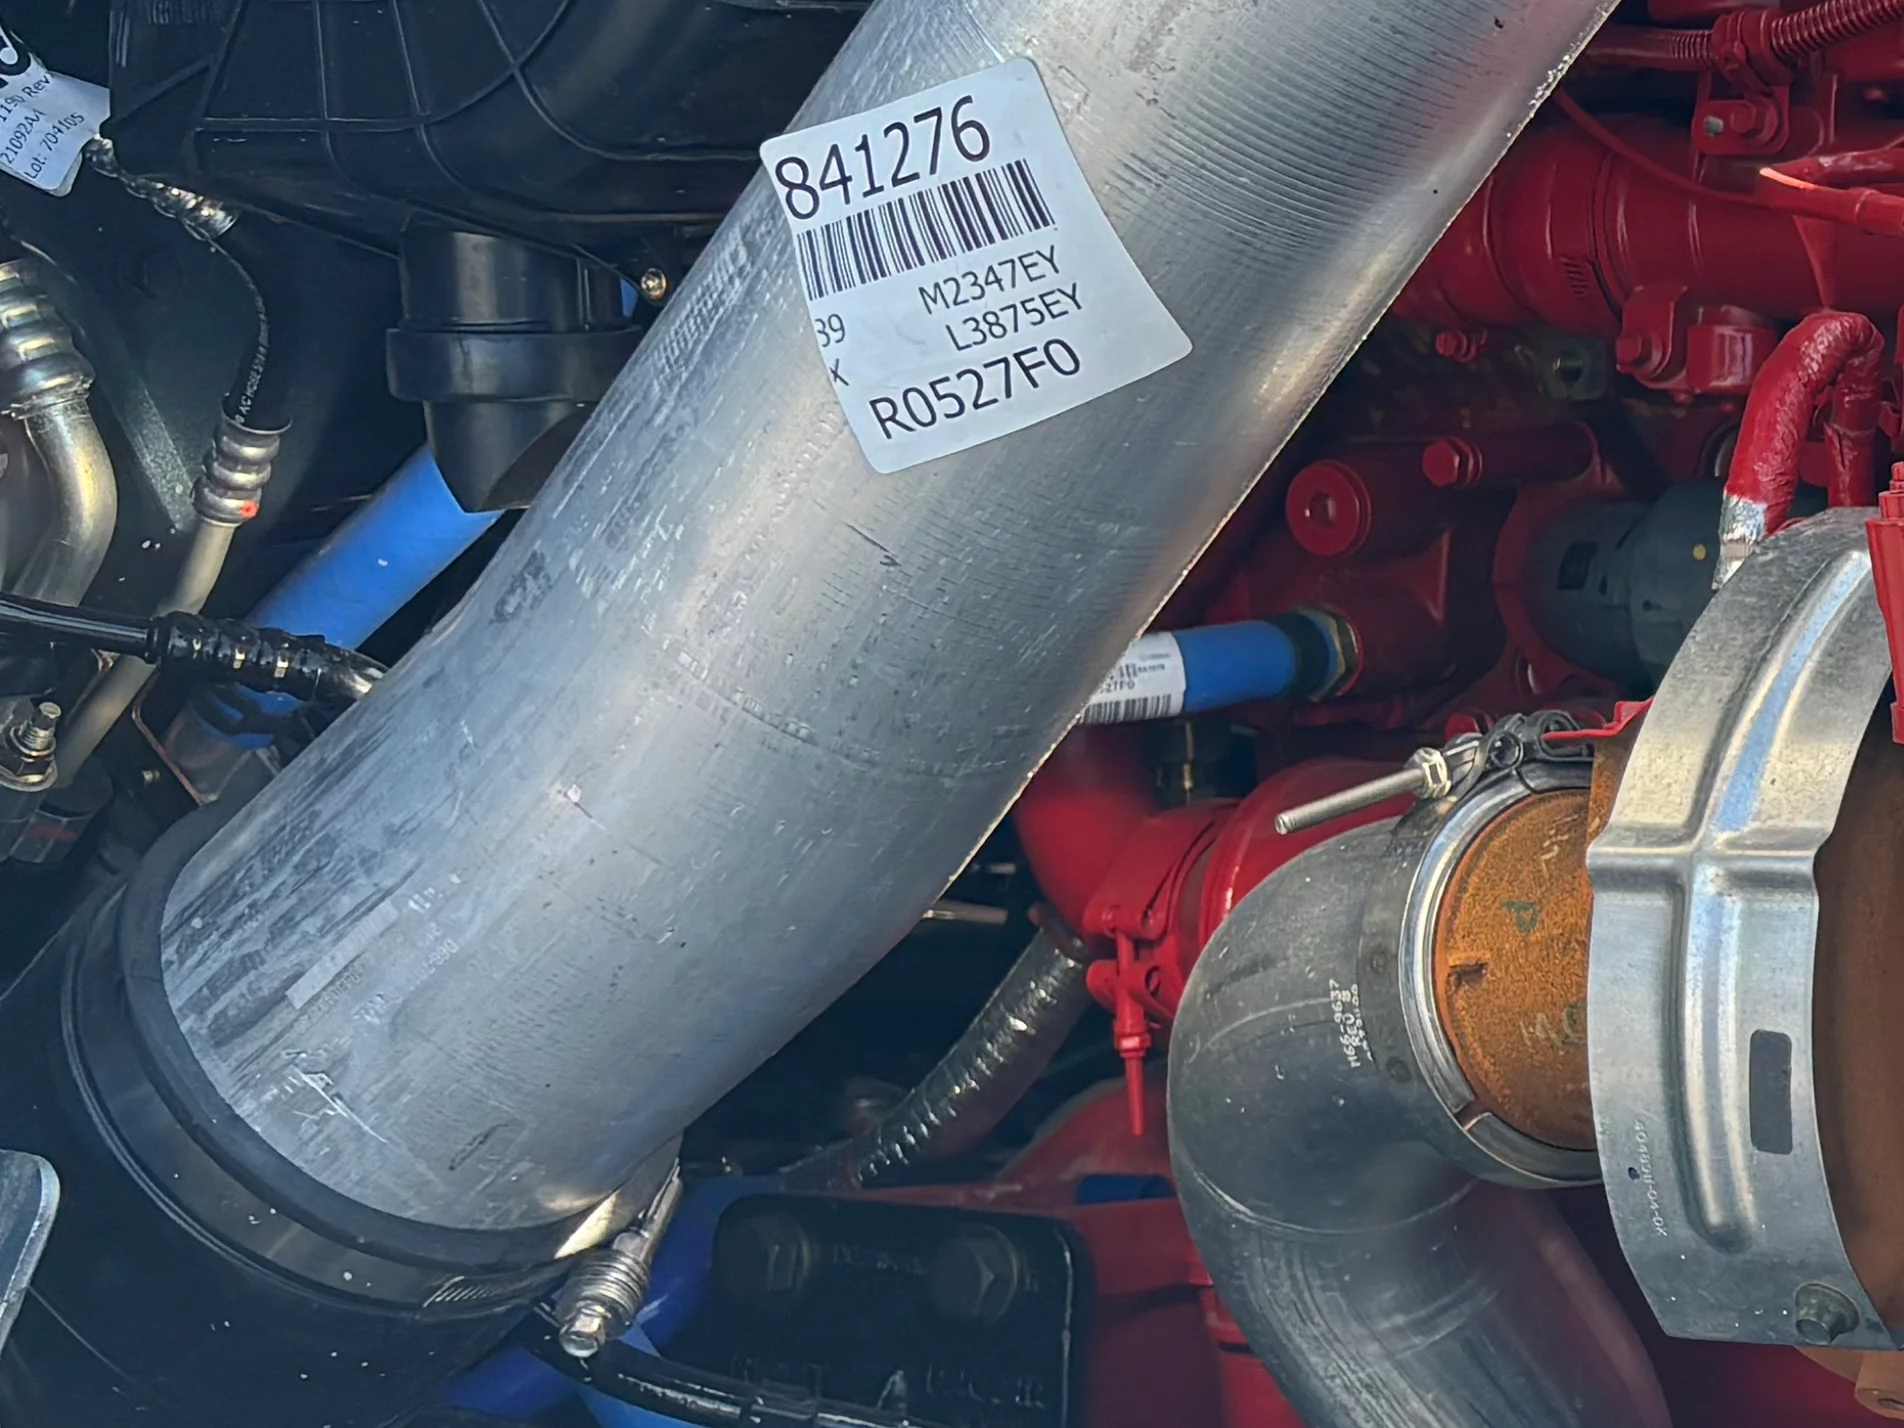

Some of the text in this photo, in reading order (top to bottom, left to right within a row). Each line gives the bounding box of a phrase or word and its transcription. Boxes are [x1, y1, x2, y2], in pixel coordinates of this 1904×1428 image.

[22, 74, 51, 98] Rev
[25, 112, 86, 180] Lot: 704105
[774, 94, 991, 221] 841276
[918, 244, 1062, 315] M2347EY
[945, 282, 1084, 352] L3875EY
